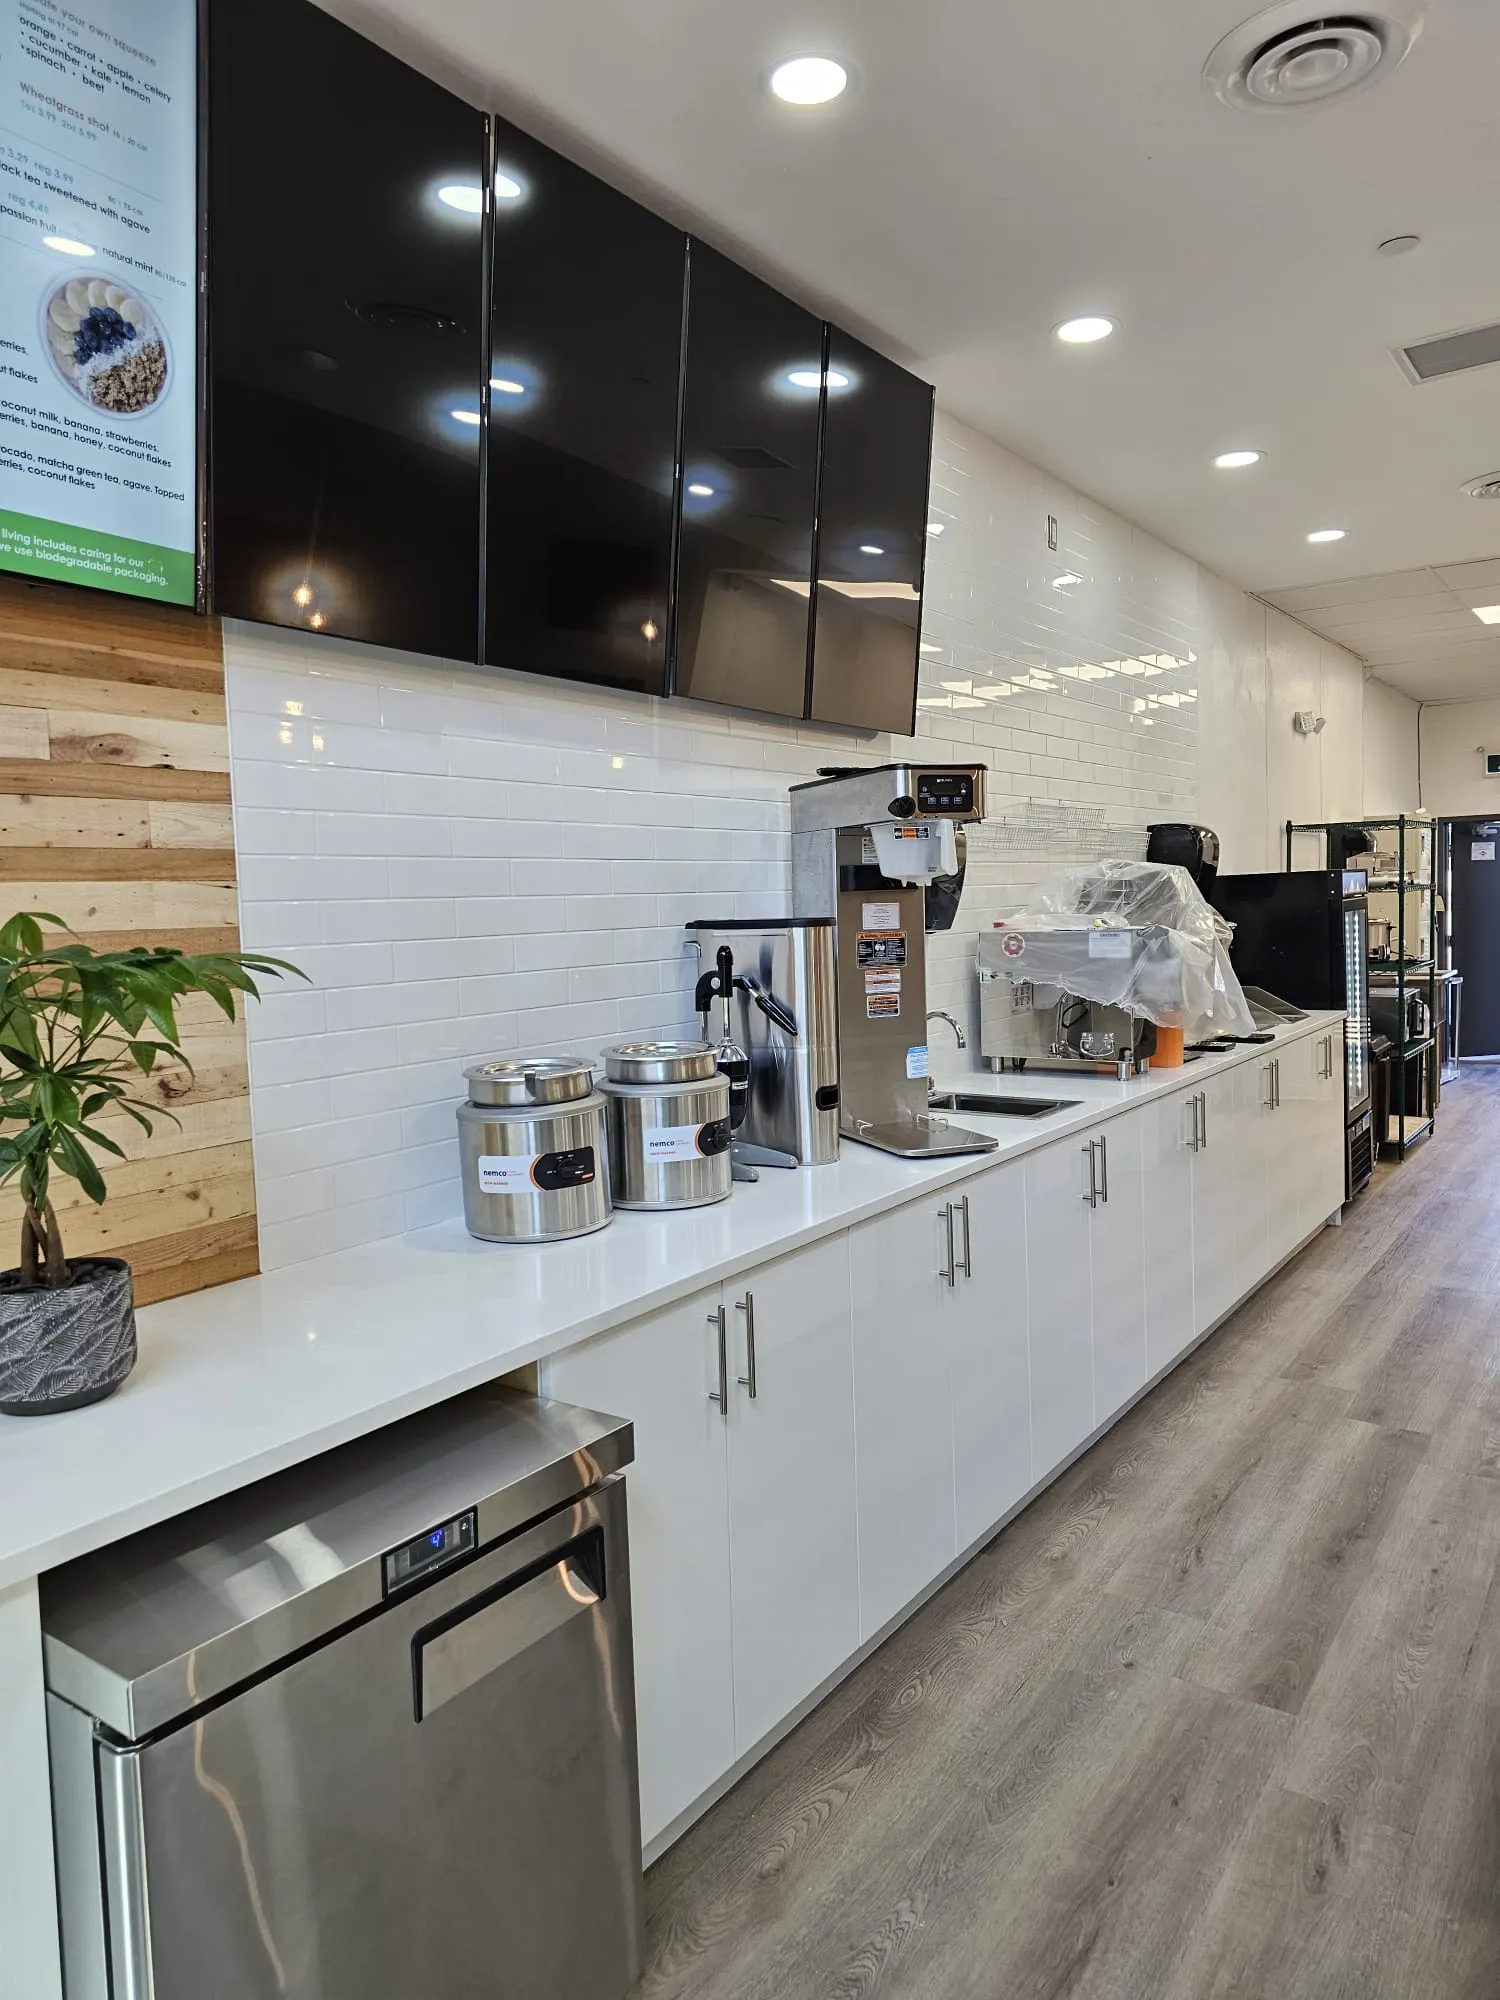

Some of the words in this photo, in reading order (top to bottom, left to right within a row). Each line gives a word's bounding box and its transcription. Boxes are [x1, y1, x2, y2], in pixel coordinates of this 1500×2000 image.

[61, 8, 86, 28] your
[89, 24, 111, 41] own
[114, 38, 156, 67] squeeze
[20, 16, 56, 40] orange
[67, 42, 96, 62] carrot
[107, 63, 134, 82] apple
[144, 83, 172, 104] celery
[29, 35, 81, 67] cucumber
[91, 65, 112, 84] kale
[122, 81, 151, 105] lemon
[82, 73, 104, 93] beet
[20, 81, 85, 120] Wheatgrass
[87, 116, 110, 133] shot
[34, 162, 52, 176] reg
[8, 192, 26, 207] reg
[24, 171, 41, 186] tea
[43, 181, 97, 211] sweetened
[100, 206, 119, 220] with
[121, 216, 150, 234] agave
[0, 205, 38, 226] passion
[39, 218, 57, 233] fruit
[102, 247, 133, 265] natural
[134, 259, 153, 274] mint
[9, 367, 38, 384] flakes
[0, 400, 36, 416] oconut
[64, 416, 103, 437] banana,
[74, 432, 105, 450] honey,
[108, 444, 145, 460] coconut
[146, 453, 172, 468] flakes
[0, 446, 35, 463] ocado,
[38, 456, 74, 472] matcha
[76, 466, 103, 479] green
[154, 486, 185, 501] Topped
[27, 466, 67, 483] coconut
[68, 475, 96, 490] flakes
[2, 527, 31, 546] living
[33, 535, 77, 554] includes
[79, 547, 112, 563] caring
[113, 552, 126, 564] for
[128, 558, 145, 568] our
[14, 546, 33, 557] use
[35, 548, 112, 573] biodegradable
[114, 567, 169, 586] packaging.
[649, 1139, 675, 1148] nemco
[483, 1169, 507, 1178] nemco
